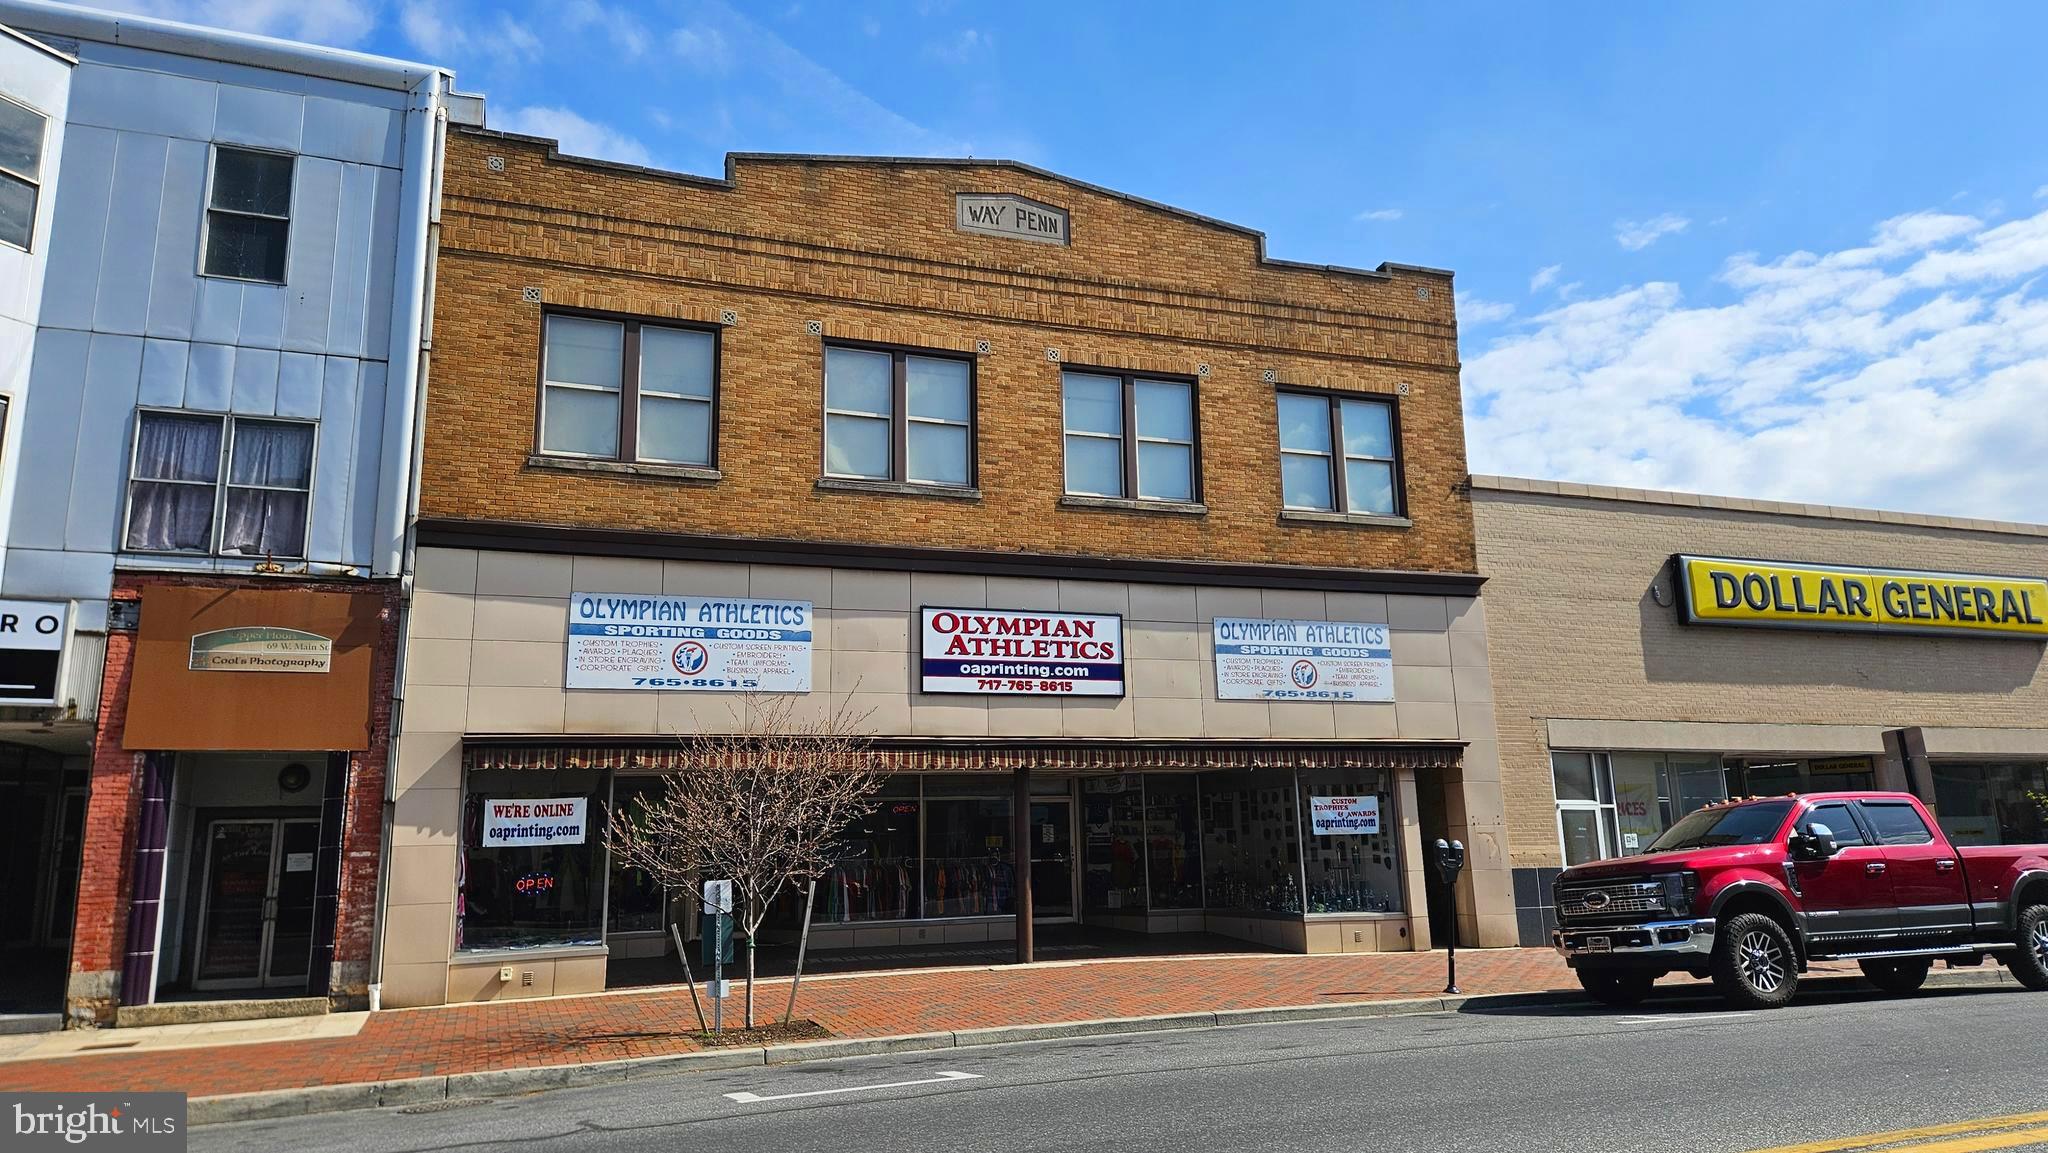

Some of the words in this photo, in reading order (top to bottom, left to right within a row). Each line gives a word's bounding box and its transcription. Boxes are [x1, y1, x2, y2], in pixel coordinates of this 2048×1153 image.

[968, 206, 1006, 225] WAY
[1016, 208, 1058, 234] PENN
[1710, 571, 1872, 617] DOLLAR
[1882, 580, 2043, 624] GENERAL
[580, 598, 686, 622] OLYMPIAN
[699, 602, 804, 625] ATHLETICS
[932, 612, 1096, 638] OLYMPIAN
[604, 625, 705, 638] SPORTING
[717, 628, 782, 640] GOODS
[1220, 622, 1297, 642] OLYMPIAN
[1306, 626, 1384, 644] ATHLETICS
[266, 642, 278, 650] 69
[280, 642, 292, 650] W.
[294, 642, 317, 651] Main
[621, 640, 659, 648] TROPHIES
[746, 643, 772, 651] SCREEN
[774, 644, 803, 652] PRINTING
[944, 634, 1114, 660] ATHLETICS
[1240, 645, 1314, 656] SPORTING
[1321, 649, 1370, 658] GOODS
[212, 656, 248, 665] Cool's
[250, 657, 326, 668] Photography
[588, 656, 615, 664] STORE
[752, 659, 788, 667] UNIFORMS
[580, 664, 632, 672] CORPORATE
[960, 663, 1089, 678] oaprinting.com
[977, 680, 1073, 692] 717-765-8615
[494, 803, 530, 818] WE'RE
[534, 804, 574, 818] ONLINE
[892, 804, 918, 814] OPEN
[1316, 817, 1376, 830] oaprinting.com
[490, 823, 580, 841] oaprinting.com
[516, 876, 554, 891] OPEN
